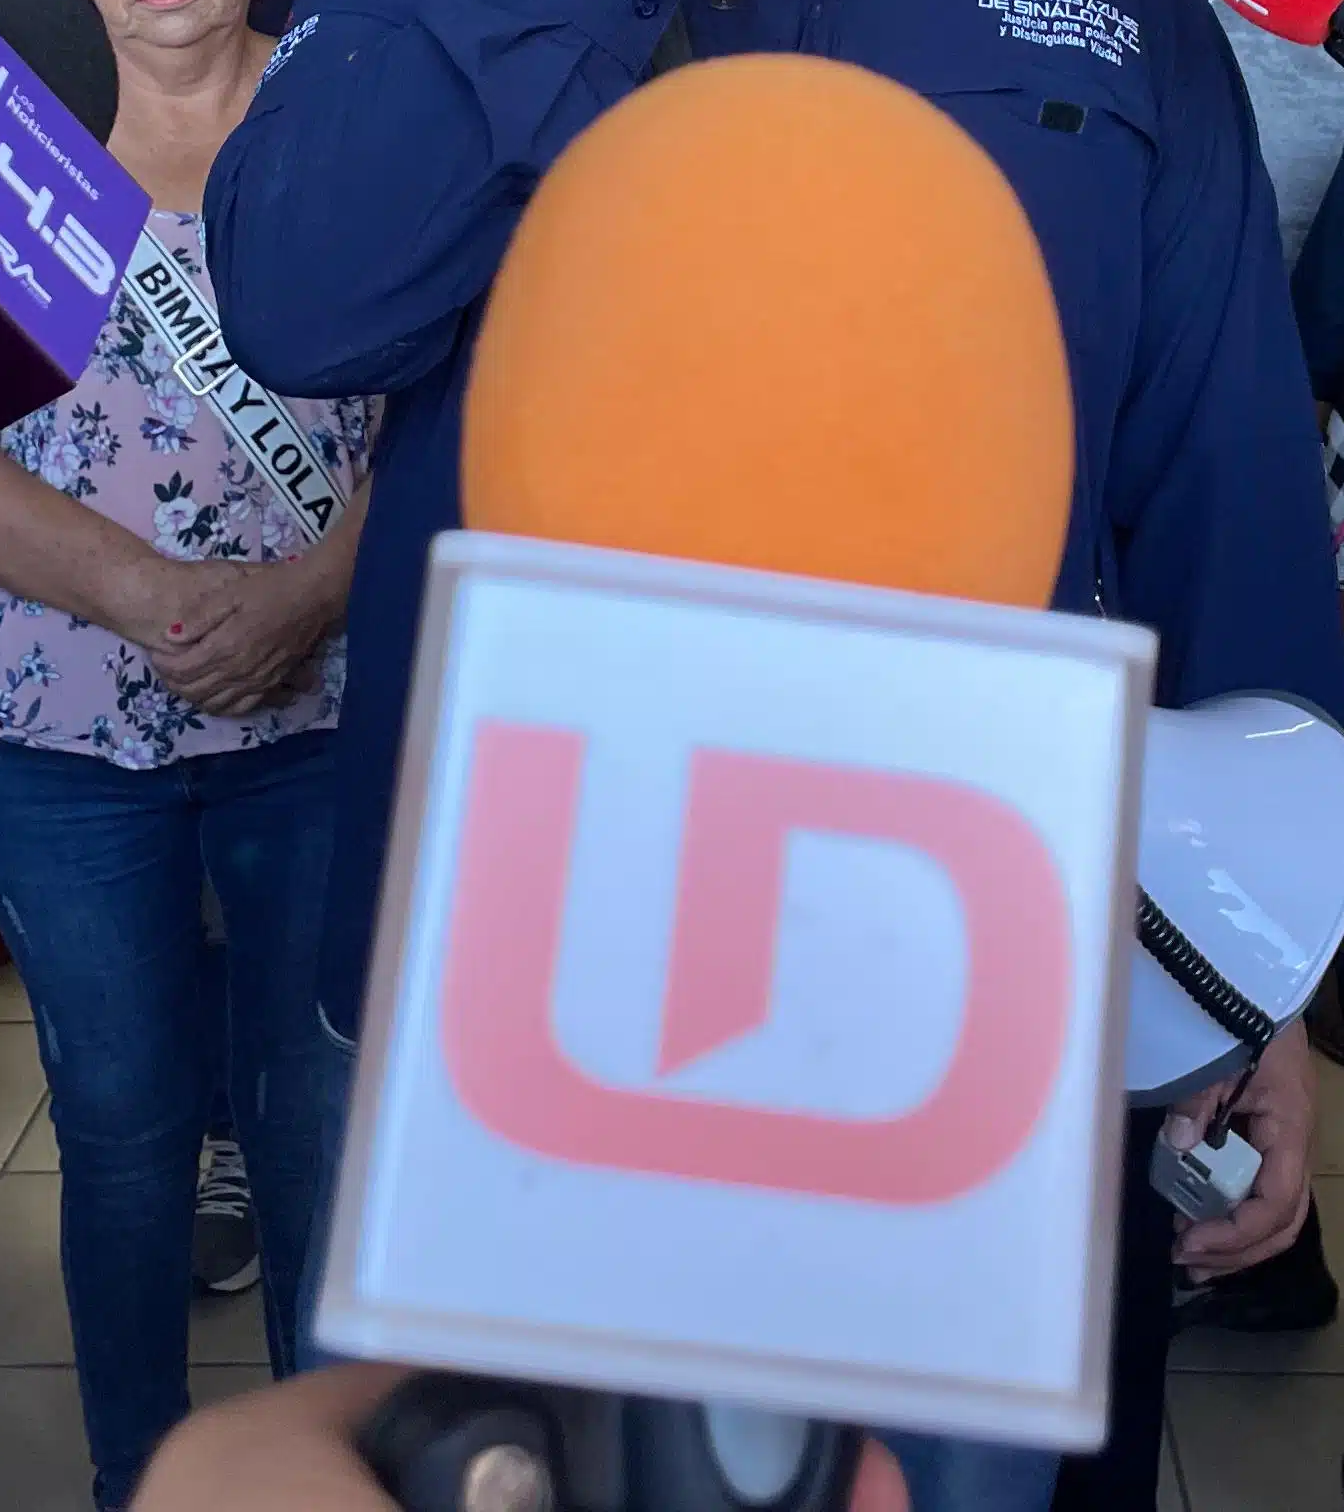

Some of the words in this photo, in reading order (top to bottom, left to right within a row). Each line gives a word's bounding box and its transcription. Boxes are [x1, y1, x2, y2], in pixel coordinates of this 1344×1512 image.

[1001, 10, 1048, 31] Justicia
[1052, 20, 1082, 34] para
[1013, 0, 1106, 31] SINALOA
[999, 24, 1007, 37] y
[1011, 25, 1087, 48] Distinguidas
[1089, 38, 1123, 67] Viudas
[6, 95, 100, 201] Noticieristas
[134, 261, 238, 394] BIMBA
[229, 377, 266, 414] Y
[251, 416, 338, 534] LOLA
